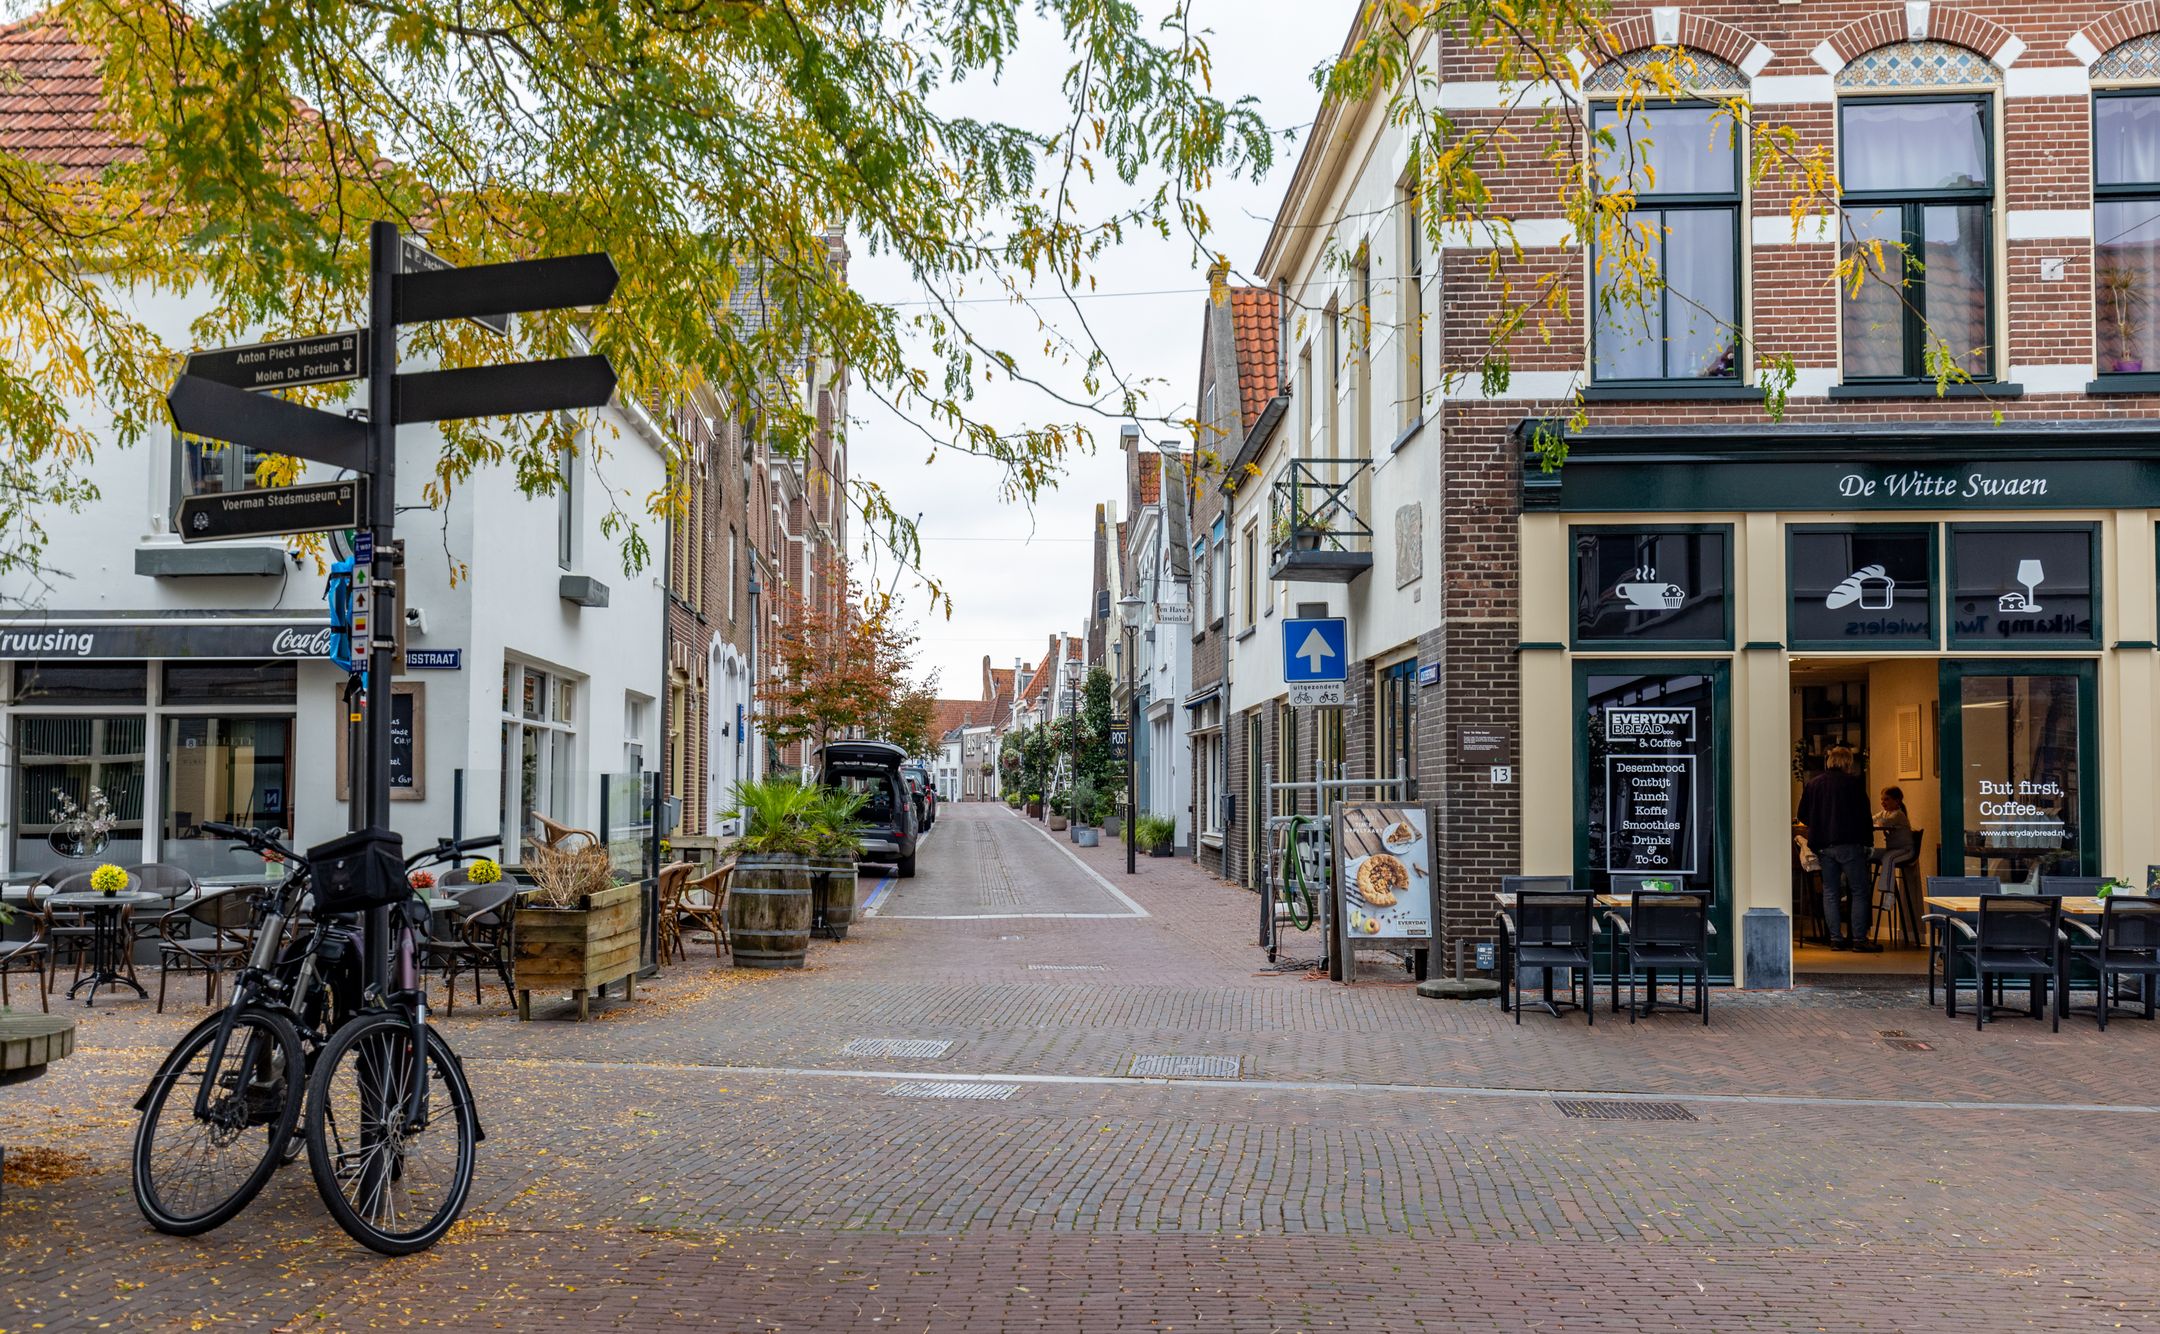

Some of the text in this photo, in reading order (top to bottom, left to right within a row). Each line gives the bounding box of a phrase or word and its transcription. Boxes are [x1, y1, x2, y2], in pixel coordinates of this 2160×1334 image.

[236, 341, 339, 364] Anton Pieck Museum
[255, 362, 339, 383] Molen De Fortuin
[1839, 470, 2048, 498] De Witte Swaen
[222, 490, 337, 512] Voerman Stadsmuseum
[0, 628, 94, 656] ruusing
[405, 653, 455, 664] ISSTRAAT
[1612, 713, 1689, 724] EVERYDAY
[1112, 731, 1127, 744] POST
[1639, 738, 1682, 748] & Coffee
[1616, 763, 1686, 773] Desembrood
[1493, 768, 1508, 782] 13
[1632, 777, 1671, 788] Ontbijt
[1979, 780, 2065, 798] But first,
[1633, 791, 1670, 801] Lunch
[1635, 806, 1668, 815] Koffie
[1622, 820, 1681, 830] Smoothies
[1980, 829, 2065, 838] www.everydaybread.nl
[1632, 835, 1671, 845] Drinks
[1647, 845, 1657, 855] &
[1635, 855, 1669, 864] To-Go
